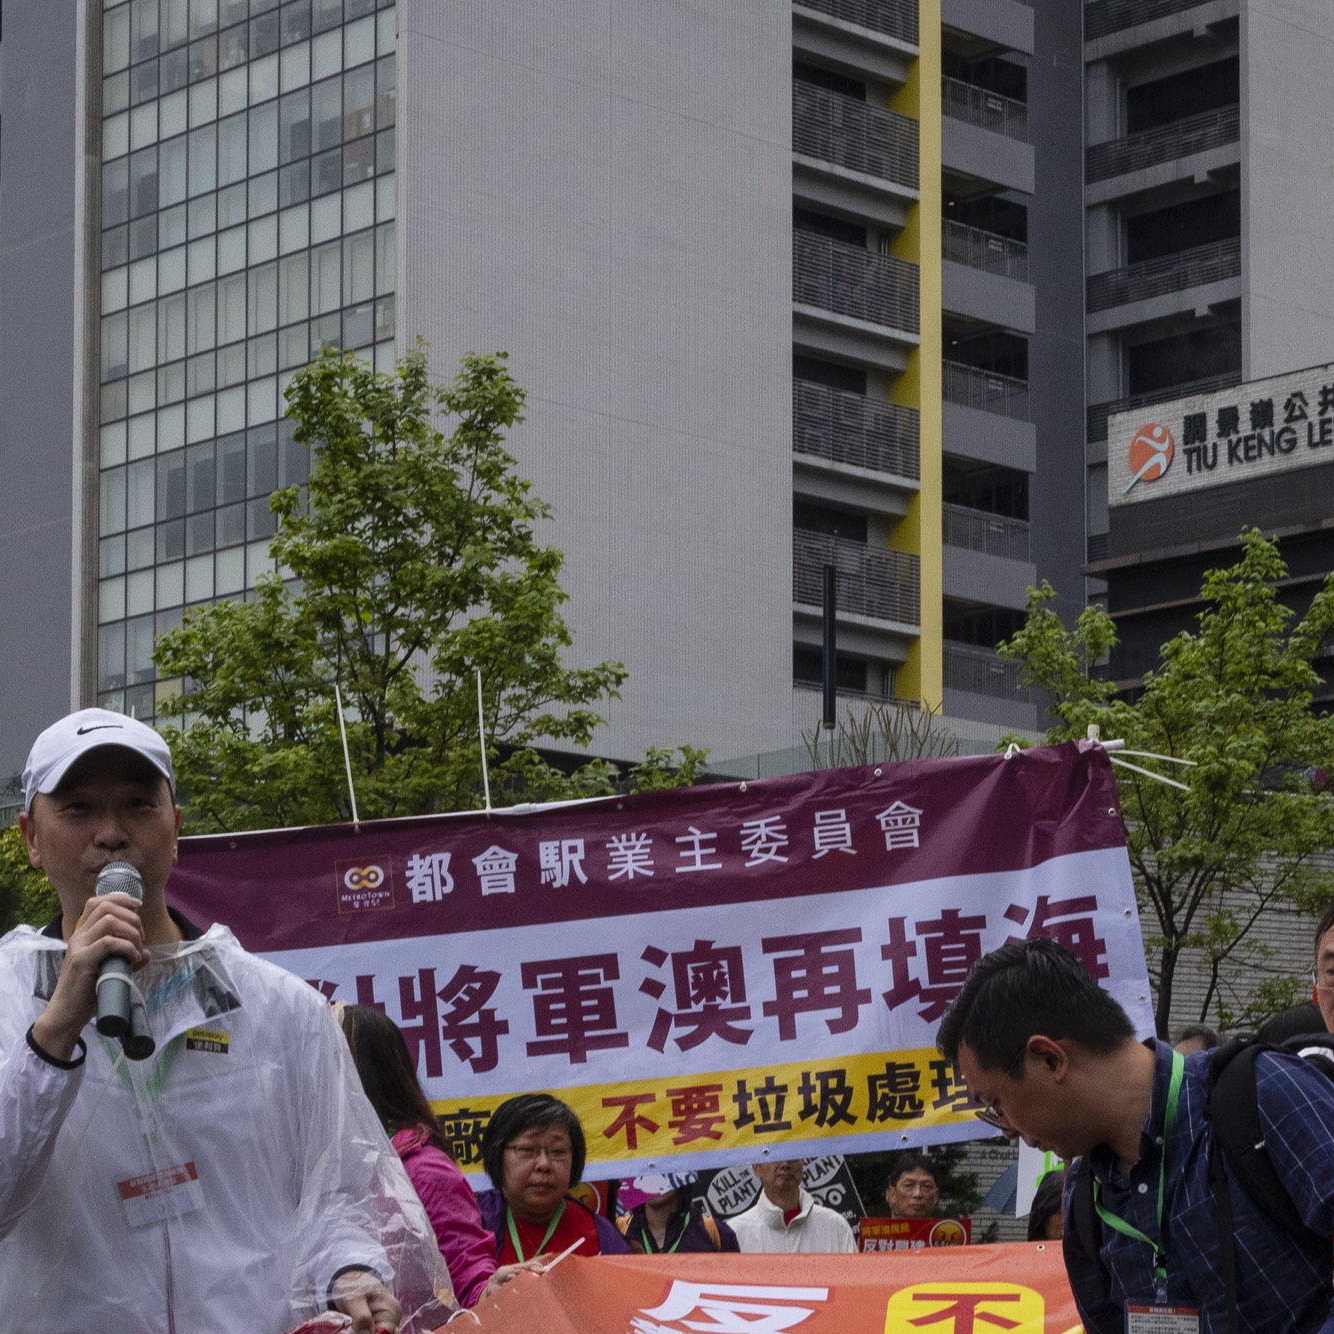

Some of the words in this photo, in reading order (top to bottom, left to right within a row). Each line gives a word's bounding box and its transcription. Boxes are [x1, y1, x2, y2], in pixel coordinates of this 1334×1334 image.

[1182, 441, 1218, 475] TIU
[1227, 426, 1298, 466] KENG
[712, 1169, 741, 1196] KILL
[739, 1169, 751, 1180] THE
[718, 1178, 758, 1214] PLANT
